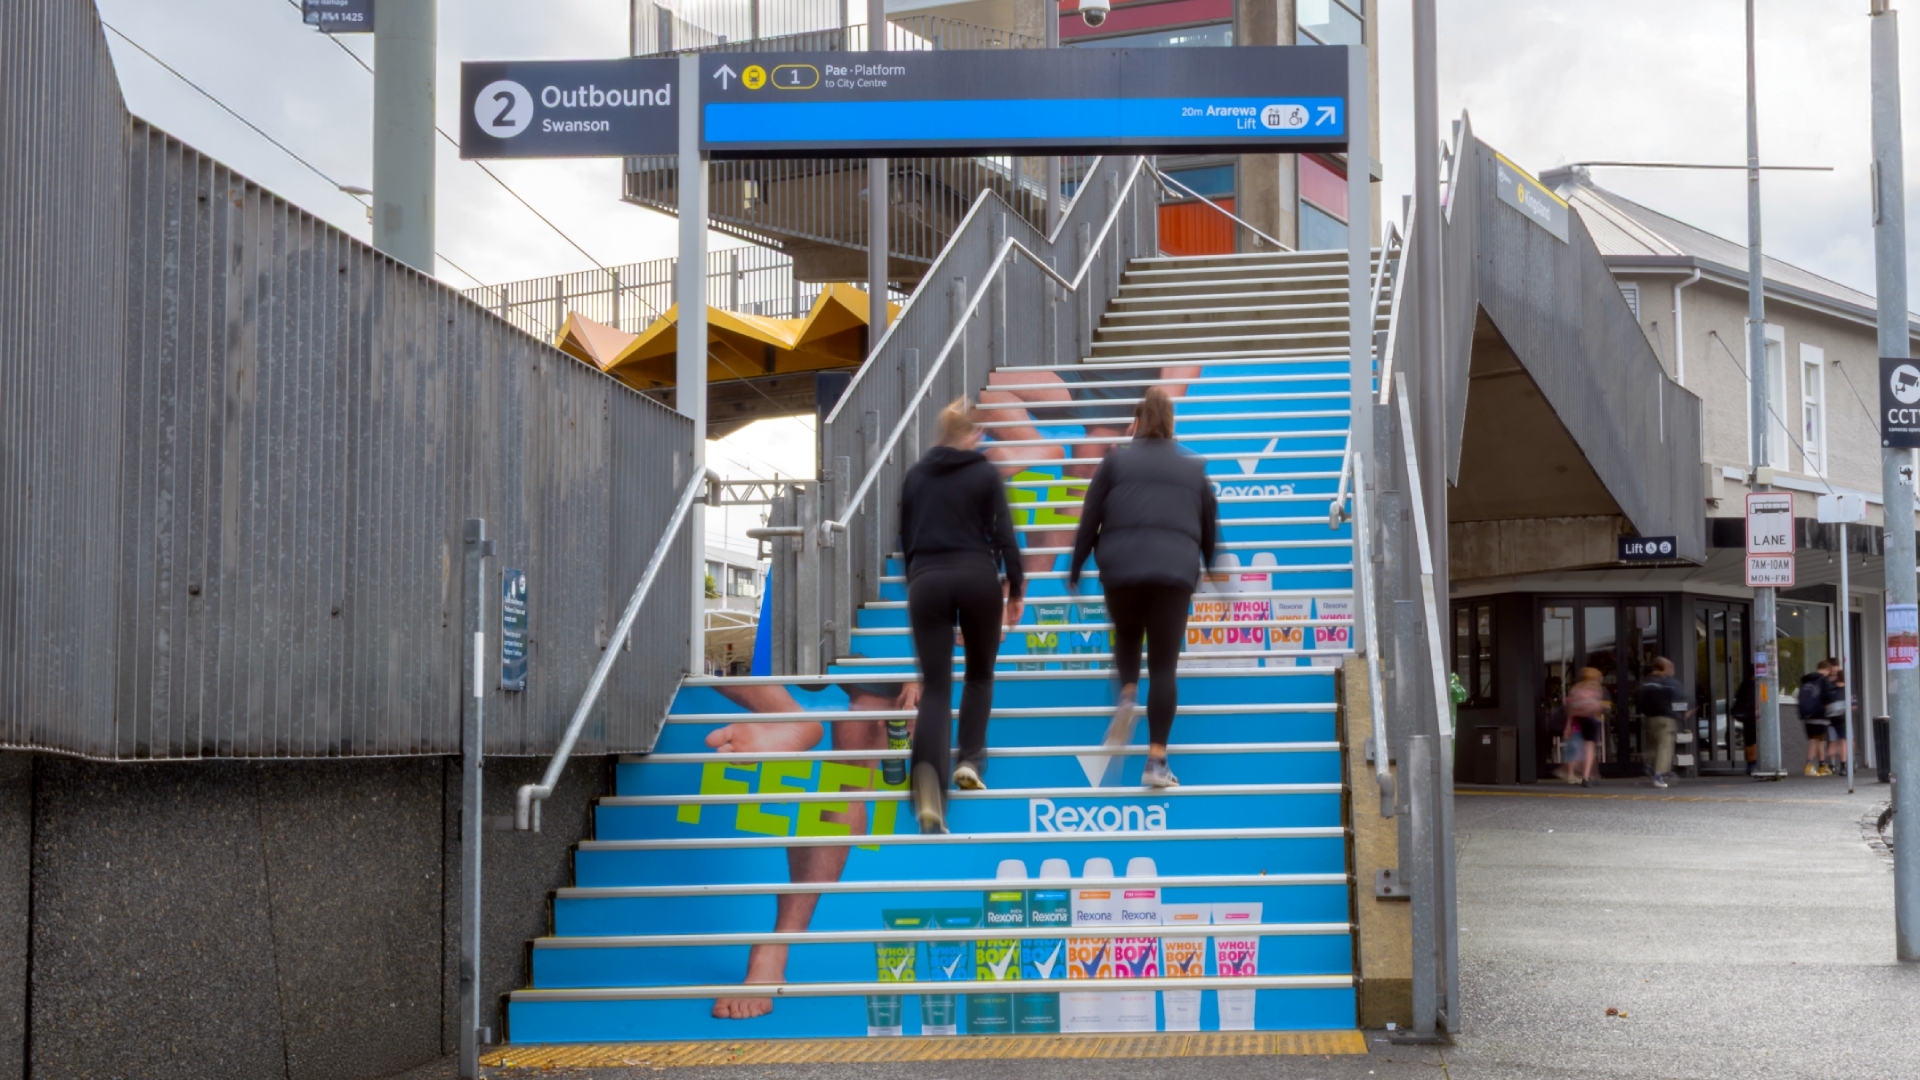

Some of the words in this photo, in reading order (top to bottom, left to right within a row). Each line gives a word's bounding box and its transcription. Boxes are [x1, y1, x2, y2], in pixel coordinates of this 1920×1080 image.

[341, 13, 363, 21] 1425
[825, 64, 848, 76] Pae
[855, 64, 906, 76] Platform
[790, 69, 801, 84] 1
[825, 79, 835, 88] to
[837, 78, 854, 89] City
[857, 78, 887, 88] Centre
[541, 83, 671, 108] Outbound
[492, 91, 516, 127] 2
[1182, 107, 1203, 117] 20m
[1206, 104, 1257, 117] Ararewa
[542, 118, 610, 132] Swanson
[1237, 118, 1257, 130] Lift
[1888, 408, 1920, 424] CCT
[1753, 534, 1787, 546] LANE
[1625, 543, 1643, 554] Lift
[1751, 559, 1790, 570] 7AM-10AM
[1751, 574, 1790, 583] MON-FRI
[1232, 601, 1269, 612] WHOLE
[1029, 798, 1167, 833] Rexona
[988, 912, 1023, 923] Rexona
[1032, 910, 1068, 922] Rexona
[1077, 910, 1112, 921] Rexona
[1122, 909, 1156, 920] Rexona
[1165, 942, 1203, 950] WHOLE
[1218, 941, 1255, 950] WHOLE
[877, 947, 915, 957] WHOLE
